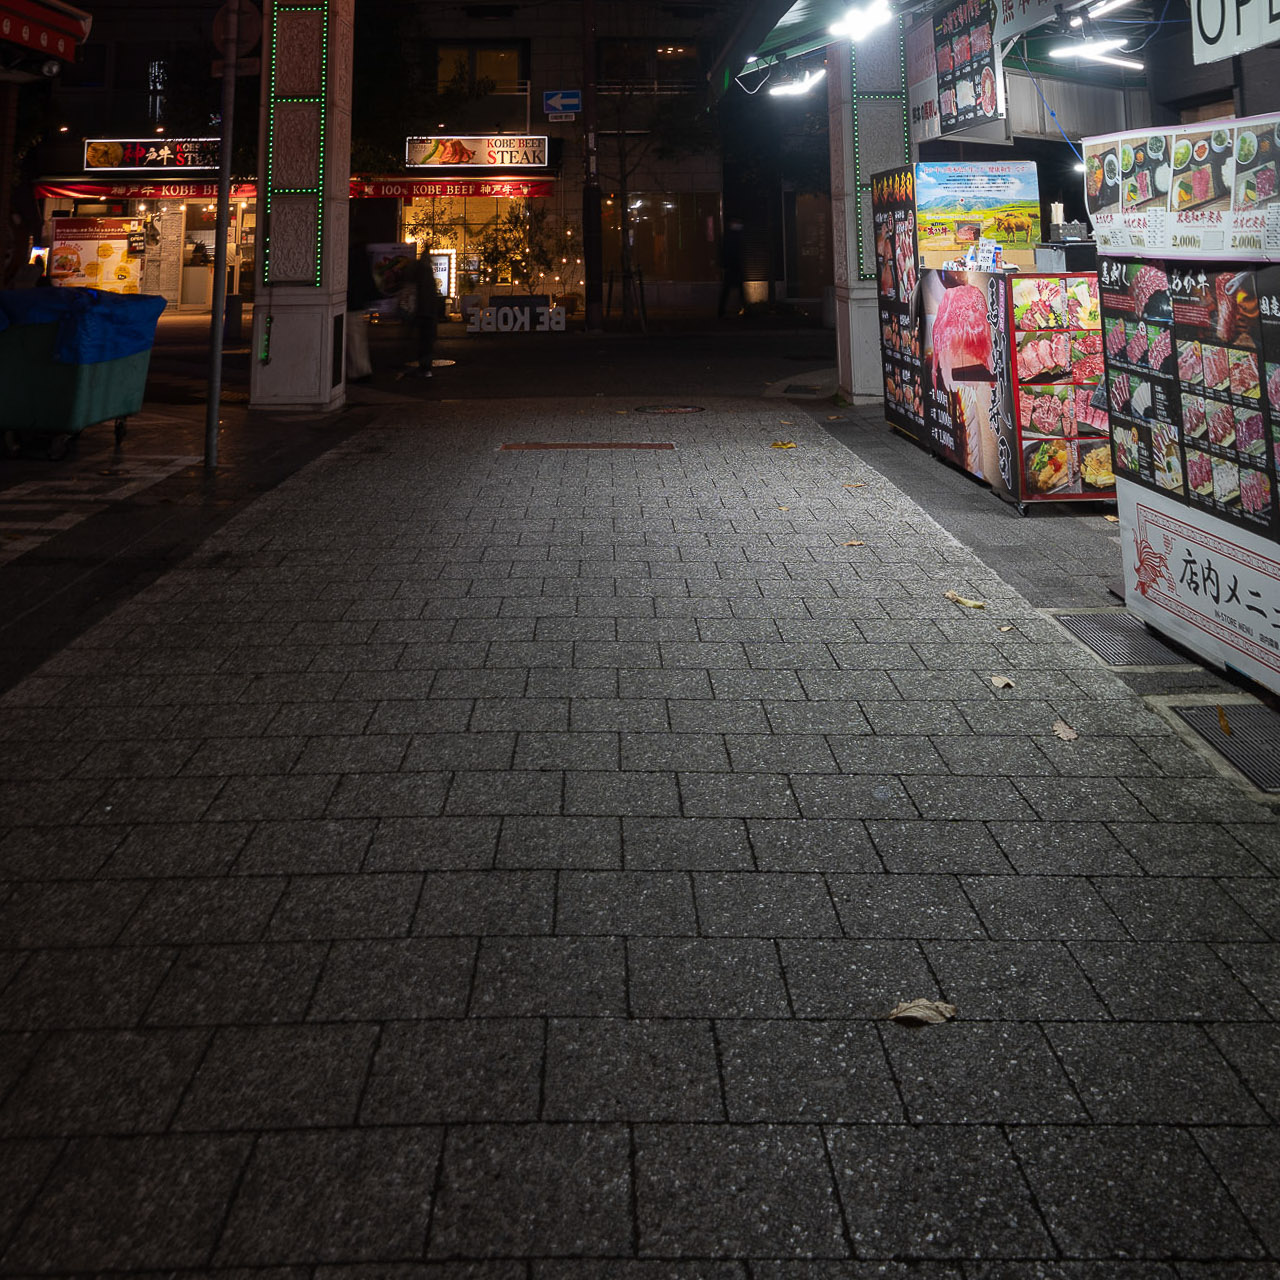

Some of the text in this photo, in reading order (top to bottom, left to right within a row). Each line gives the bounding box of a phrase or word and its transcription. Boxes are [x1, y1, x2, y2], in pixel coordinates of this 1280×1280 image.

[486, 138, 544, 149] KOBE BEEF
[123, 141, 175, 167] 神戸牛
[486, 150, 544, 165] STEAK
[160, 184, 198, 196] KOBE
[412, 186, 442, 195] KOBE
[446, 186, 475, 195] BEEF
[480, 184, 514, 195] 神戸牛
[1101, 261, 1131, 286] 馬刺し
